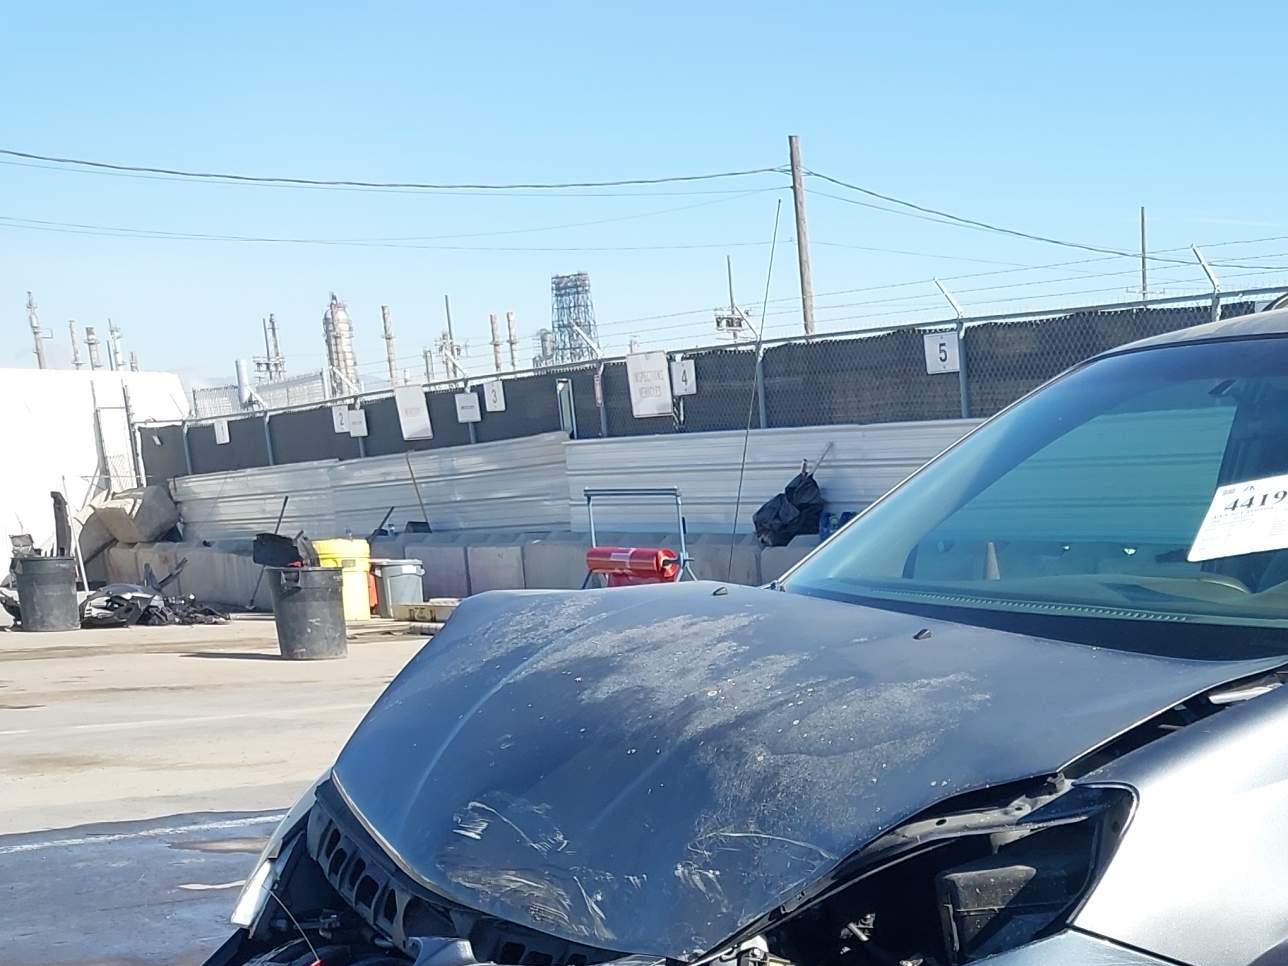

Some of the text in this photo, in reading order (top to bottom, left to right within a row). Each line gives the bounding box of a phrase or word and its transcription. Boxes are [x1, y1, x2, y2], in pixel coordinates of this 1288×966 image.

[938, 342, 948, 362] 5
[681, 369, 688, 386] 4
[491, 388, 498, 404] 3
[337, 411, 345, 426] 2
